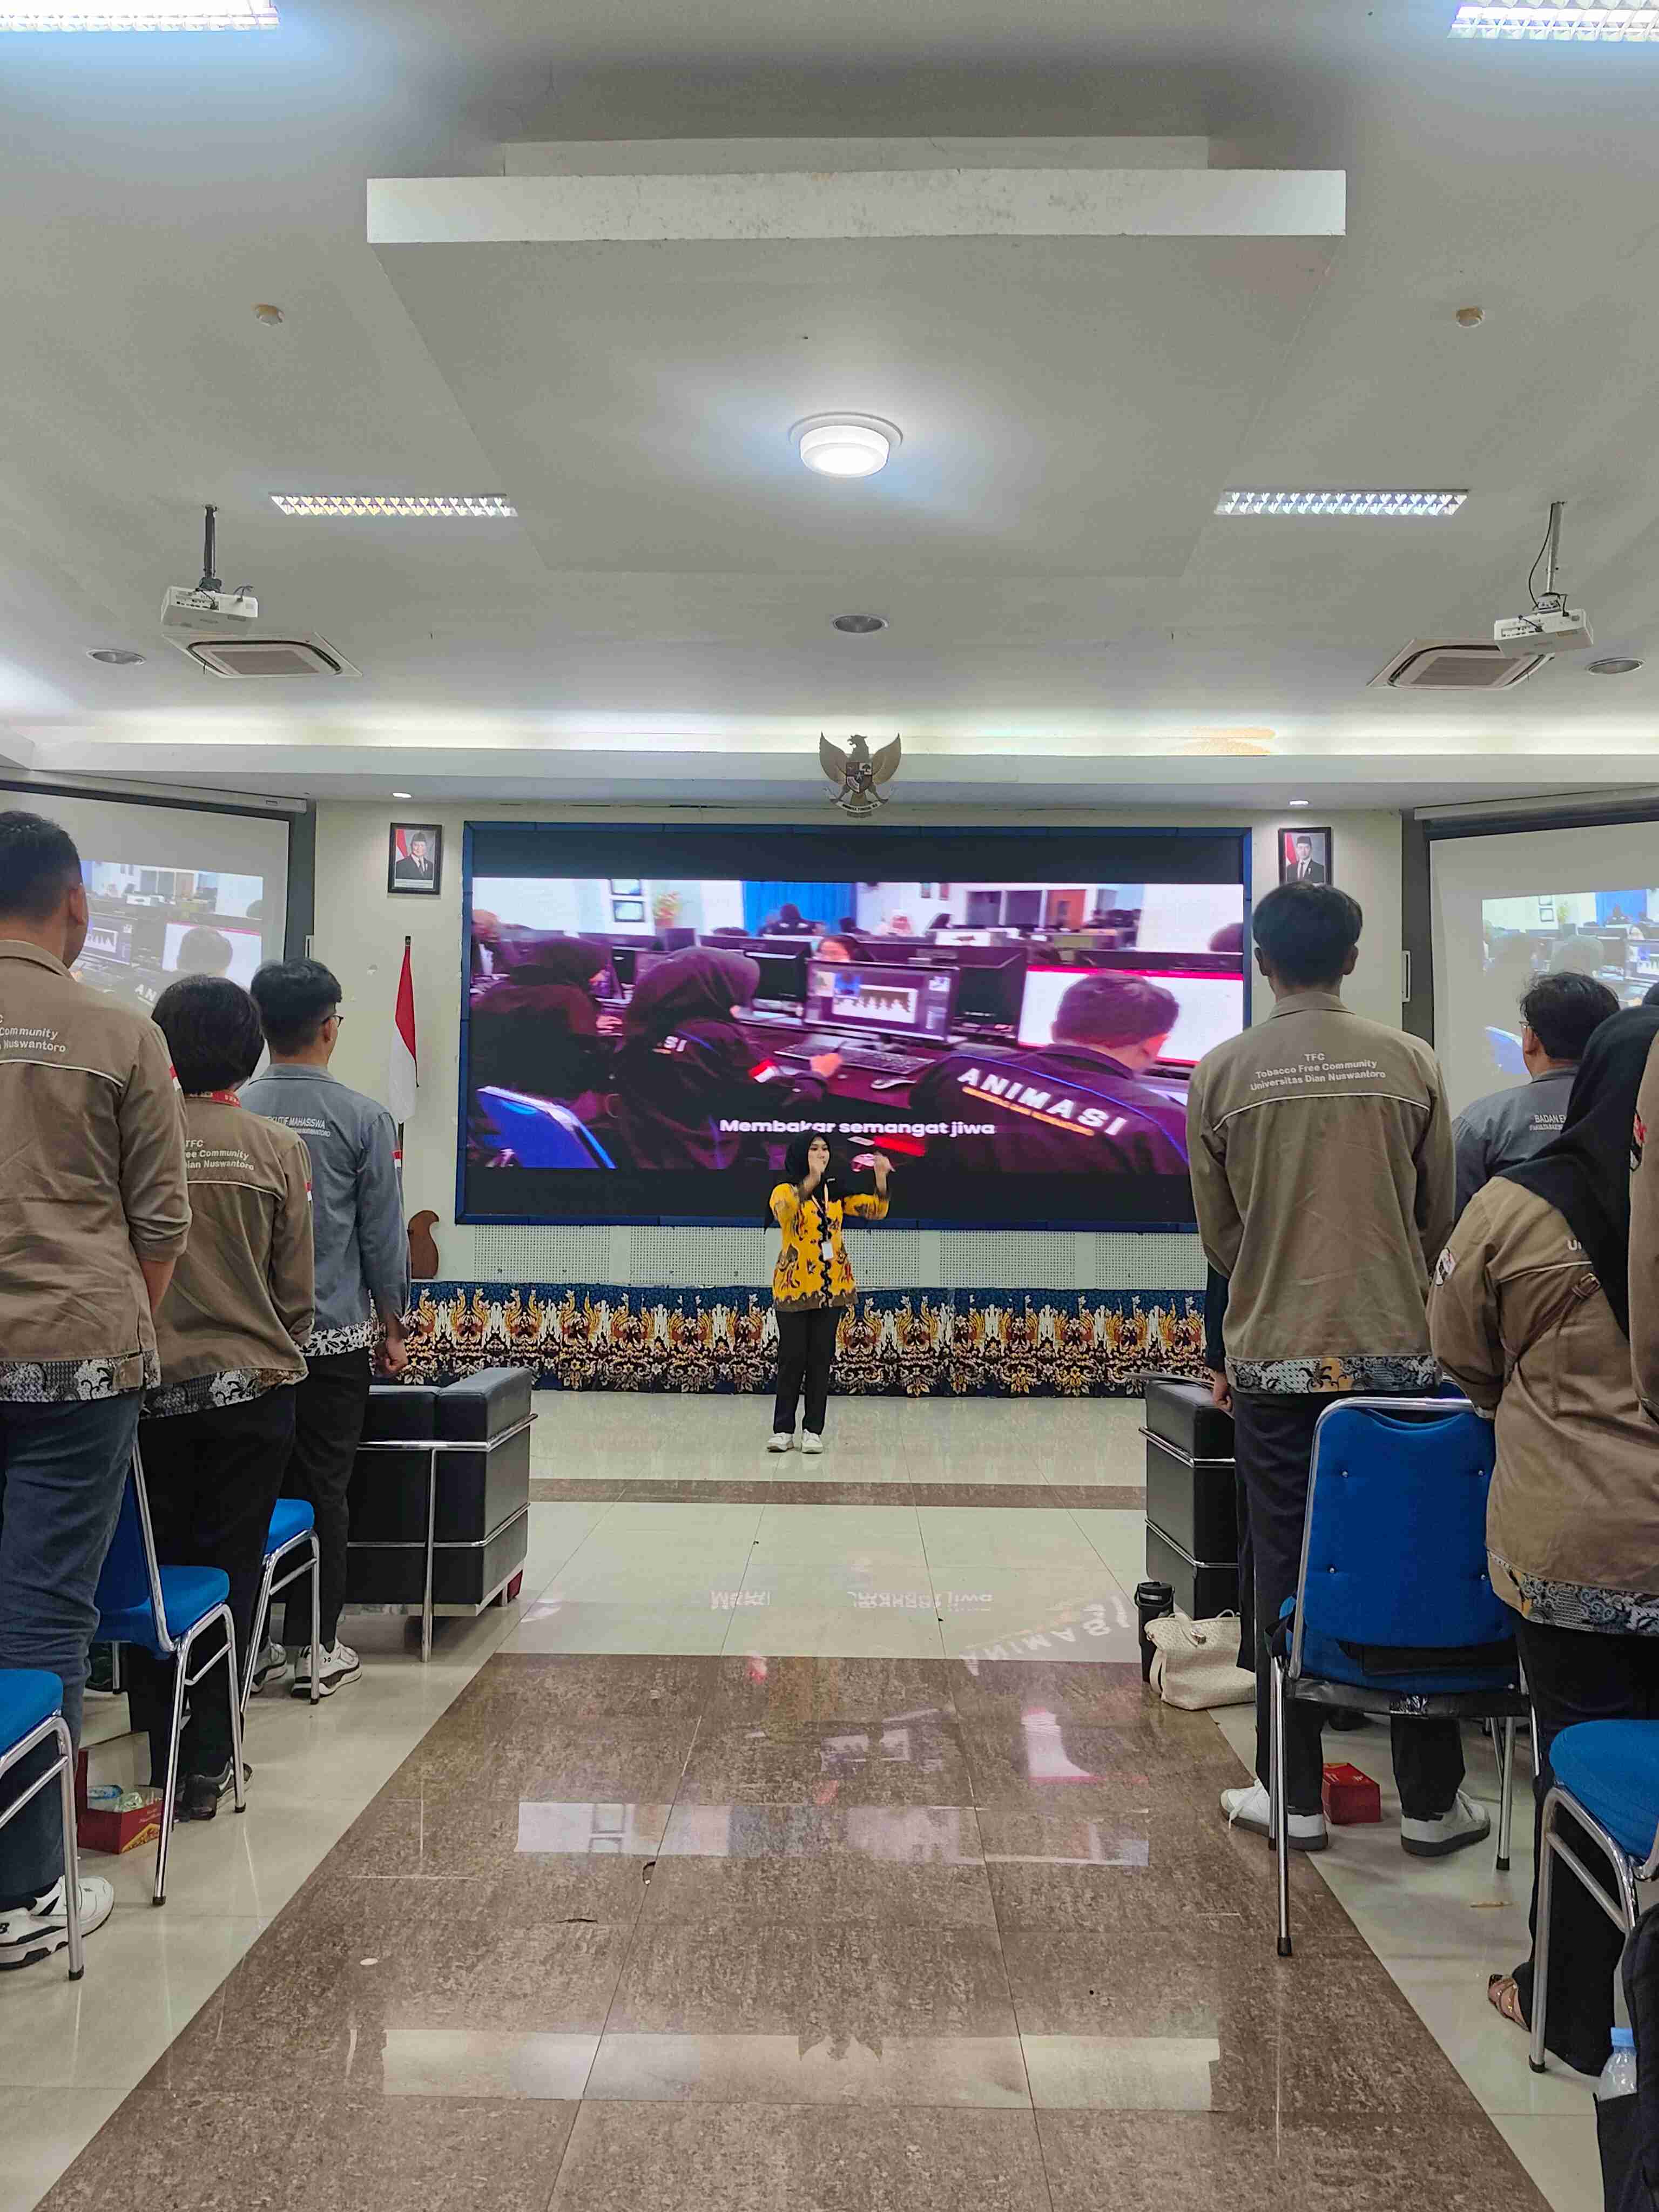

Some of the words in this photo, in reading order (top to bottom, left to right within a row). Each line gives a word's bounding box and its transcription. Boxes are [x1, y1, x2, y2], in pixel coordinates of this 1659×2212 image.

[0, 1027, 59, 1040] Community
[4, 1039, 66, 1053] Nuswantoro
[1304, 1053, 1325, 1062] TFC
[1255, 1066, 1297, 1079] Tobacco
[1298, 1064, 1320, 1073] Free
[1322, 1059, 1377, 1071] Community
[1250, 1076, 1304, 1091] Universitas
[1305, 1074, 1326, 1083] Dian
[1328, 1070, 1386, 1081] Nuswantoro
[957, 1067, 1127, 1136] ANIMASI
[1534, 1114, 1560, 1123] BADAN
[720, 1120, 836, 1133] Membakar
[839, 1121, 949, 1137] semangat
[950, 1121, 995, 1137] jiwa
[199, 1150, 249, 1161] Community
[186, 1160, 201, 1169] ian
[204, 1159, 254, 1171] Nuswantoro
